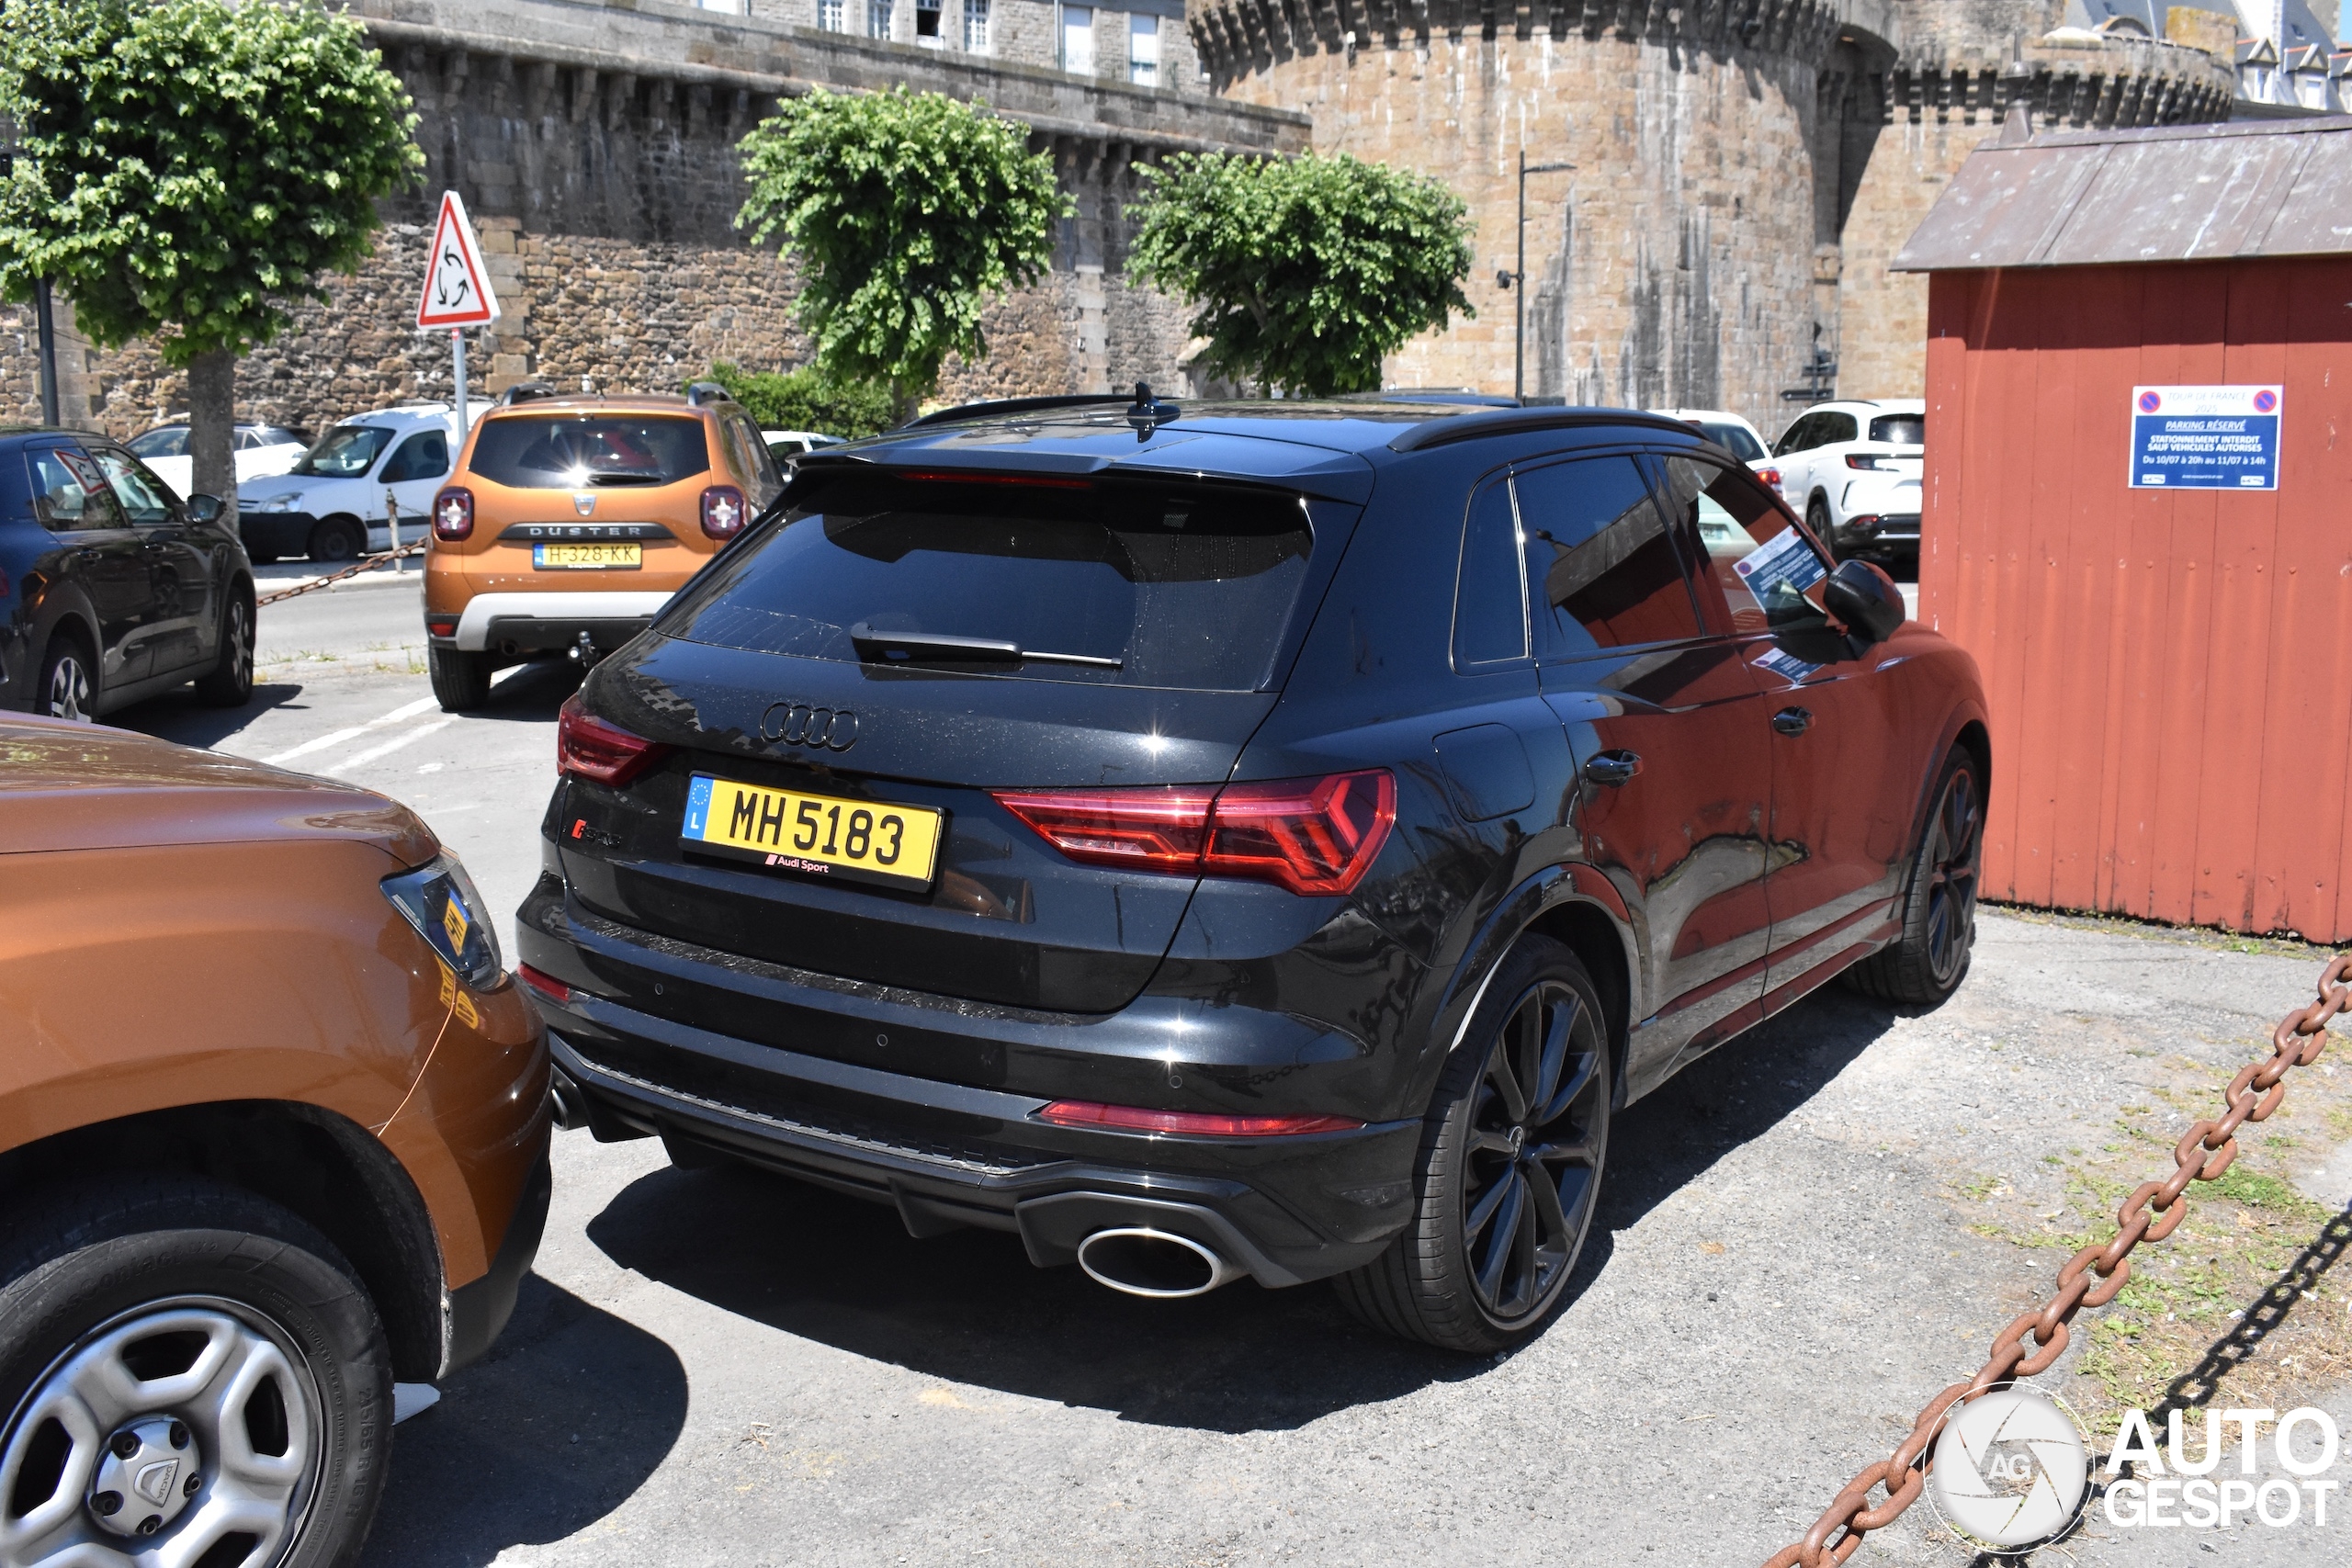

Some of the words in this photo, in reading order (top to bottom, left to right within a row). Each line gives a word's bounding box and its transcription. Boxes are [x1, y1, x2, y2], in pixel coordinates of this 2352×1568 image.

[2168, 392, 2193, 400] TOUR
[2196, 392, 2207, 400] DE
[2211, 392, 2247, 400] FRANCE
[2195, 404, 2218, 412] 2025
[2165, 421, 2205, 430] PARKING
[2206, 419, 2246, 430] RÉSERVÉ
[2150, 435, 2219, 444] STATIONNEMENT
[2221, 435, 2260, 444] INTERDIT
[2143, 456, 2154, 464] Du
[2156, 456, 2180, 465] 10/07
[2188, 456, 2203, 464] 20h
[2217, 456, 2242, 466] 11/07
[2250, 457, 2266, 466] 14h
[529, 526, 640, 536] DUSTER
[549, 545, 634, 562] H-328-KK
[690, 812, 699, 829] L
[778, 856, 799, 868] Audi
[801, 860, 829, 873] Sport
[156, 1465, 174, 1499] DACIA
